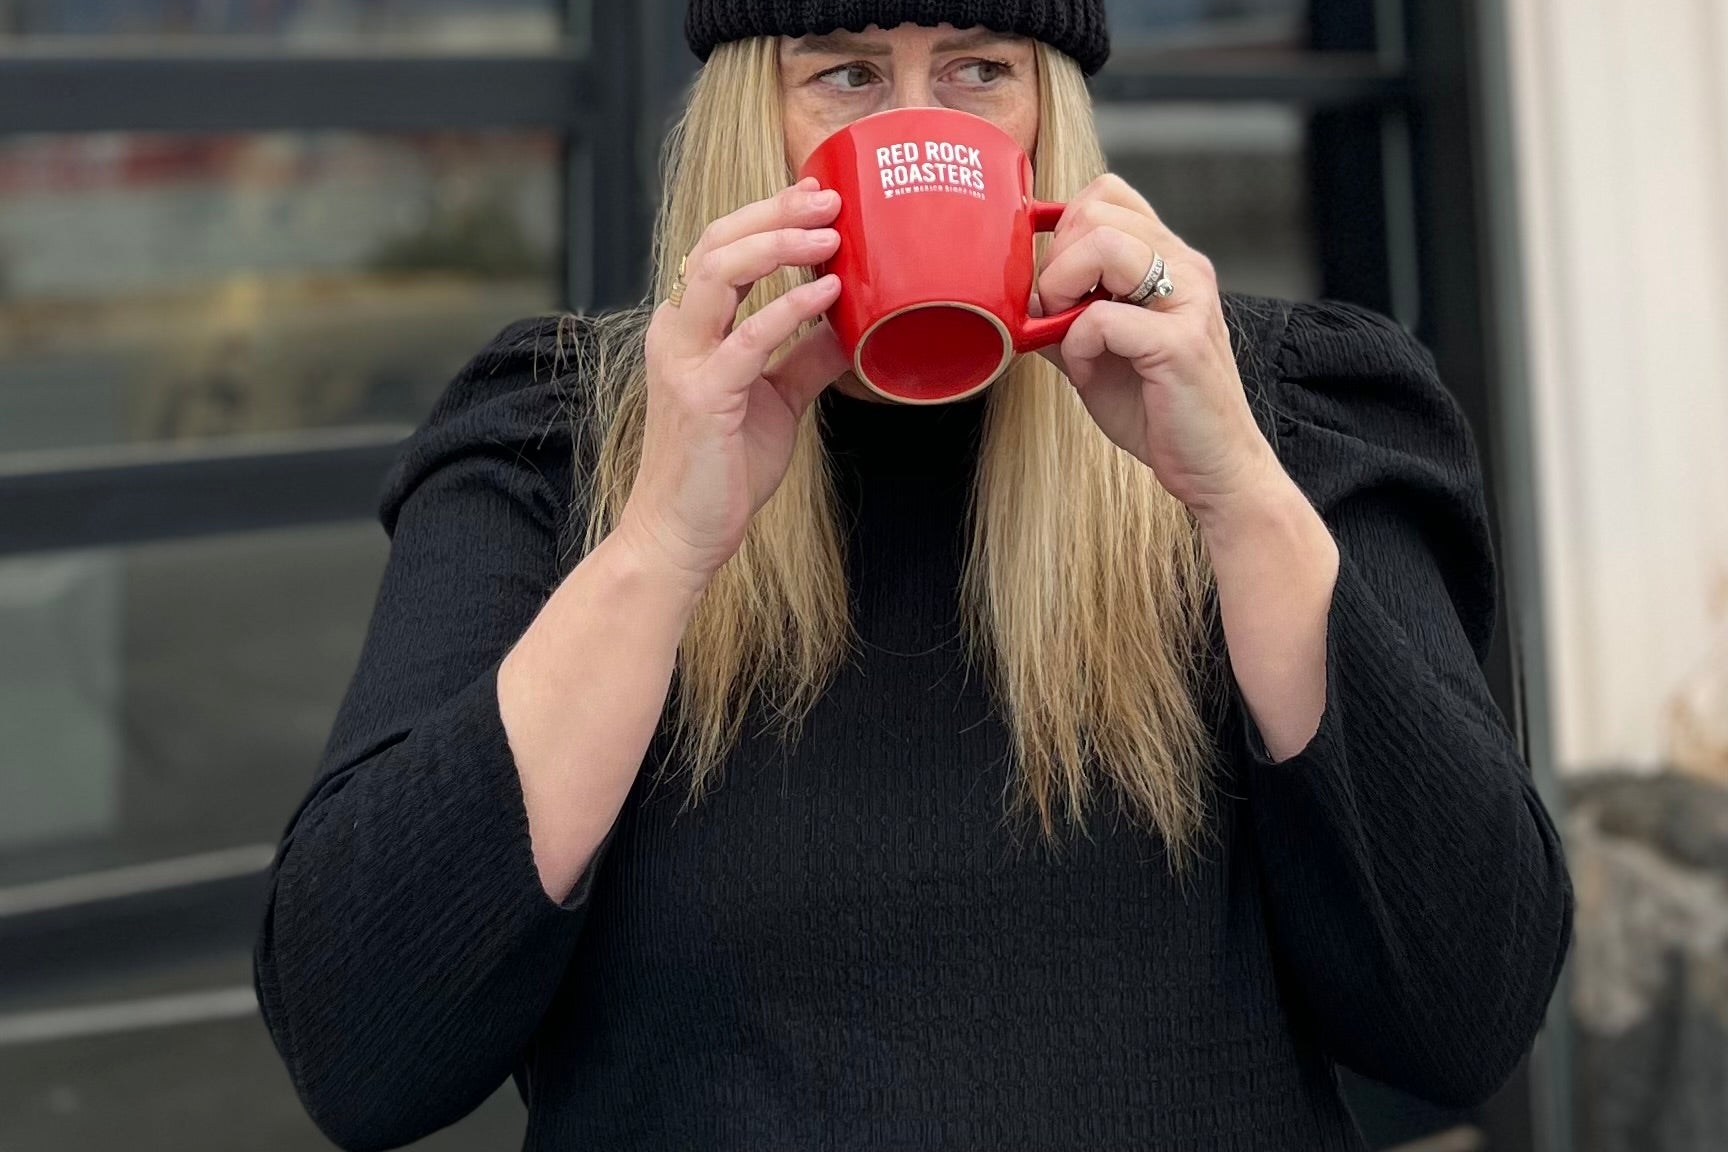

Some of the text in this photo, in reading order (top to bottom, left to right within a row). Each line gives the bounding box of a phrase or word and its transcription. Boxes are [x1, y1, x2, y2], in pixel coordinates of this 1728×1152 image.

[876, 141, 982, 169] RED ROCK
[880, 162, 985, 190] ROASTERS
